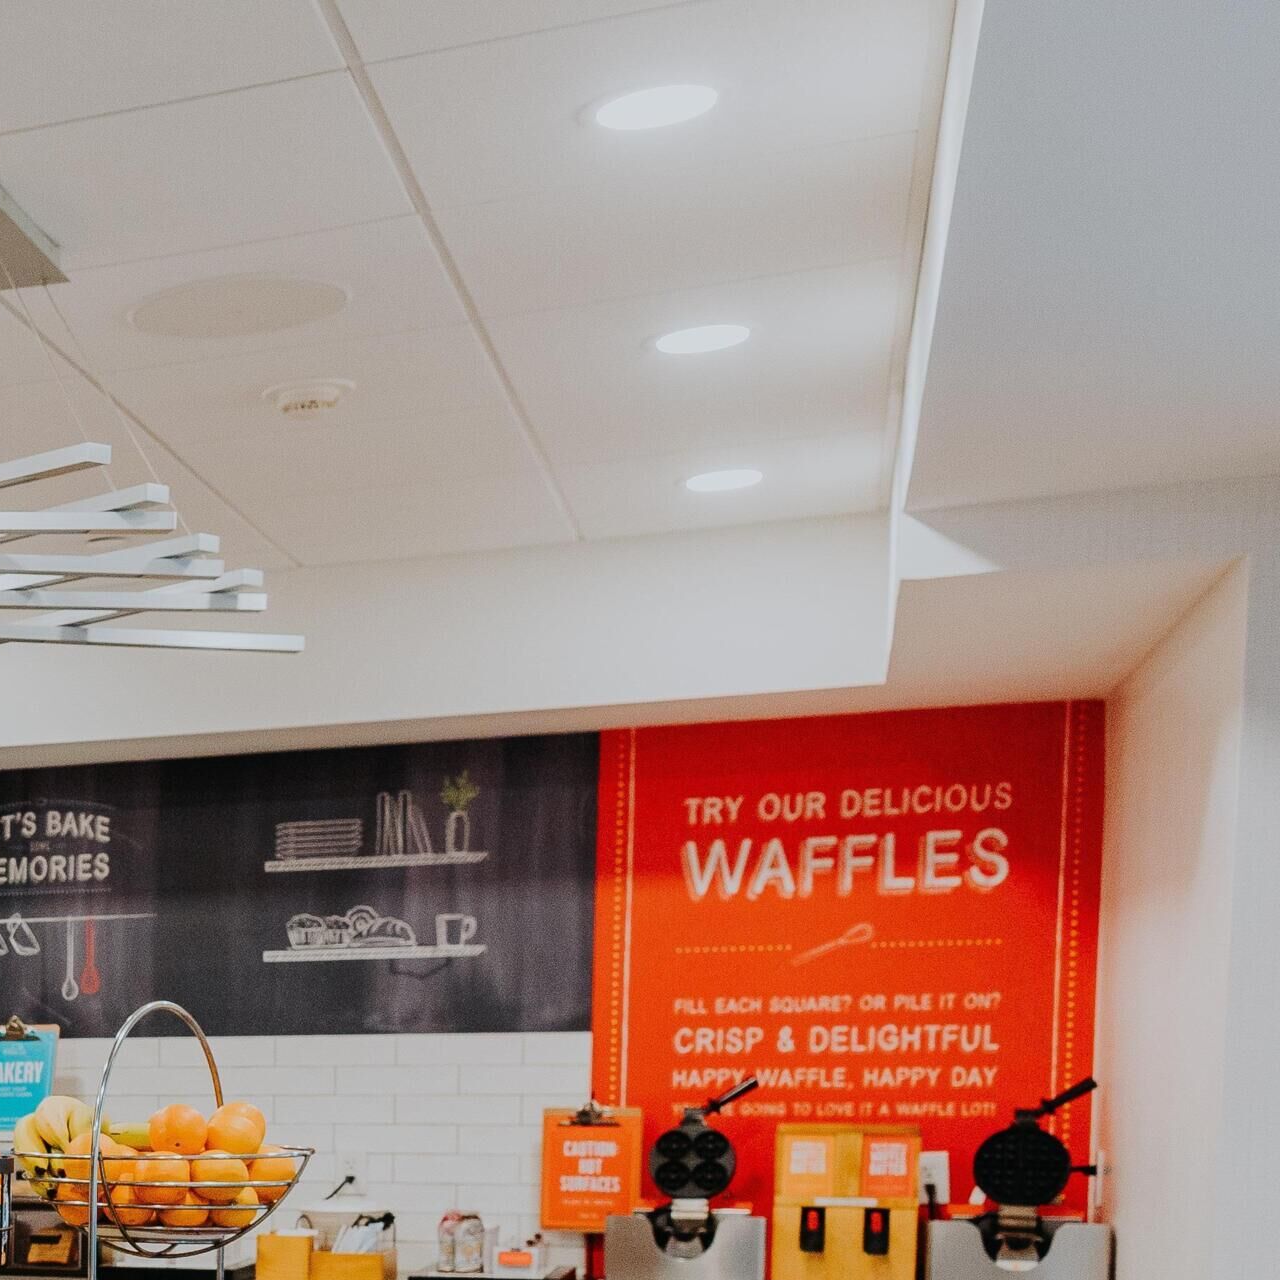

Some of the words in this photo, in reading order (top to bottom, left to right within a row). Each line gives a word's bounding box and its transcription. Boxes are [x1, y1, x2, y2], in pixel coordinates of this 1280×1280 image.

[684, 794, 744, 824] TRY
[757, 791, 827, 822] OUR
[840, 782, 1013, 819] DELICIOUS
[45, 810, 111, 843] BAKE
[681, 827, 1010, 901] WAFFLES
[673, 997, 708, 1016] FILL
[714, 996, 763, 1015] EACH
[768, 993, 853, 1014] SQUARE?
[859, 993, 887, 1011] OR
[893, 993, 933, 1012] PILE
[940, 992, 956, 1009] IT
[673, 1026, 765, 1055] CRISP
[776, 1024, 796, 1053] &
[808, 1023, 1001, 1053] DELIGHTFUL
[672, 1068, 746, 1090] HAPPY
[862, 1066, 942, 1089] HAPPY
[950, 1065, 999, 1089] DAY
[559, 1175, 621, 1193] SURFACES
